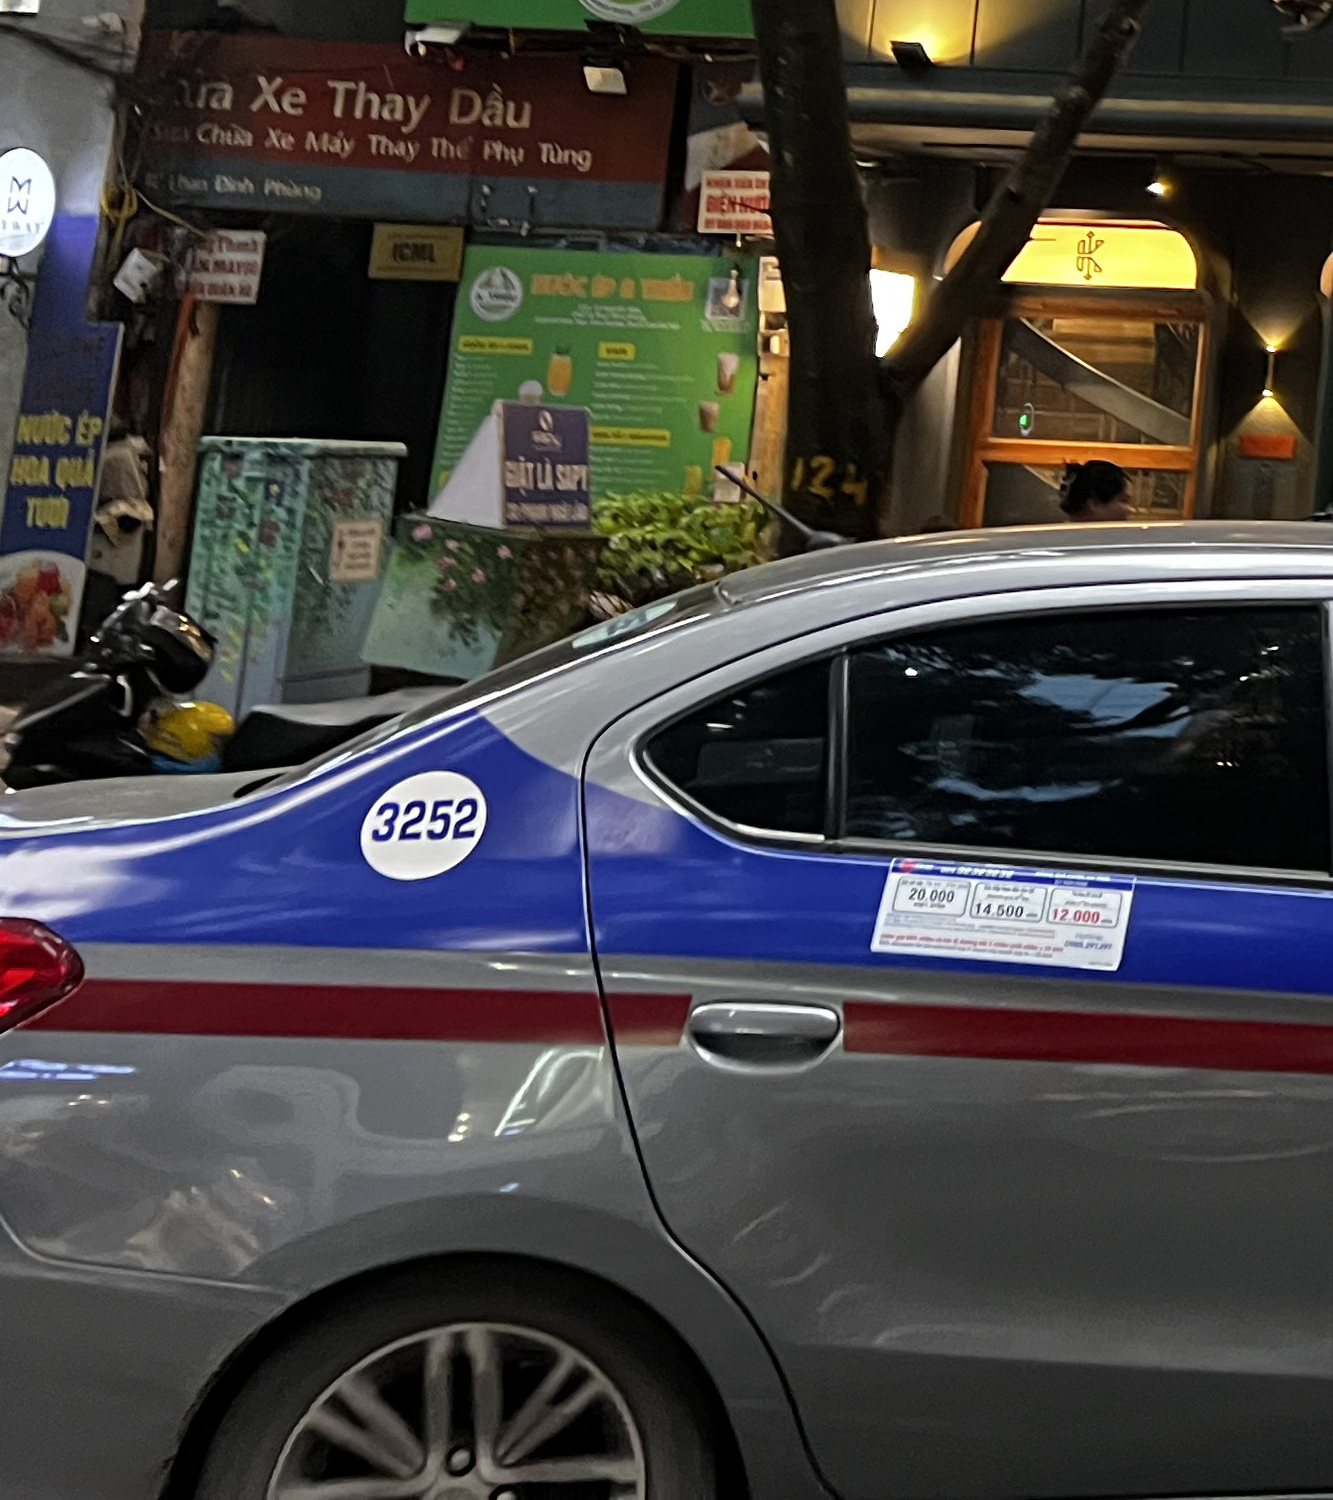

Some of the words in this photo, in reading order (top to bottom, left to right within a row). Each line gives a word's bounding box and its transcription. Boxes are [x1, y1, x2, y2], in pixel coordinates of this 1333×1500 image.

[251, 74, 307, 115] Xe
[327, 79, 431, 134] Thay
[450, 82, 532, 129] Dầu
[265, 126, 296, 151] Xe
[368, 133, 421, 163] Thay
[538, 142, 593, 173] Tùng
[372, 798, 478, 842] 3252
[908, 887, 955, 903] 20.000
[1053, 907, 1101, 924] 12.000
